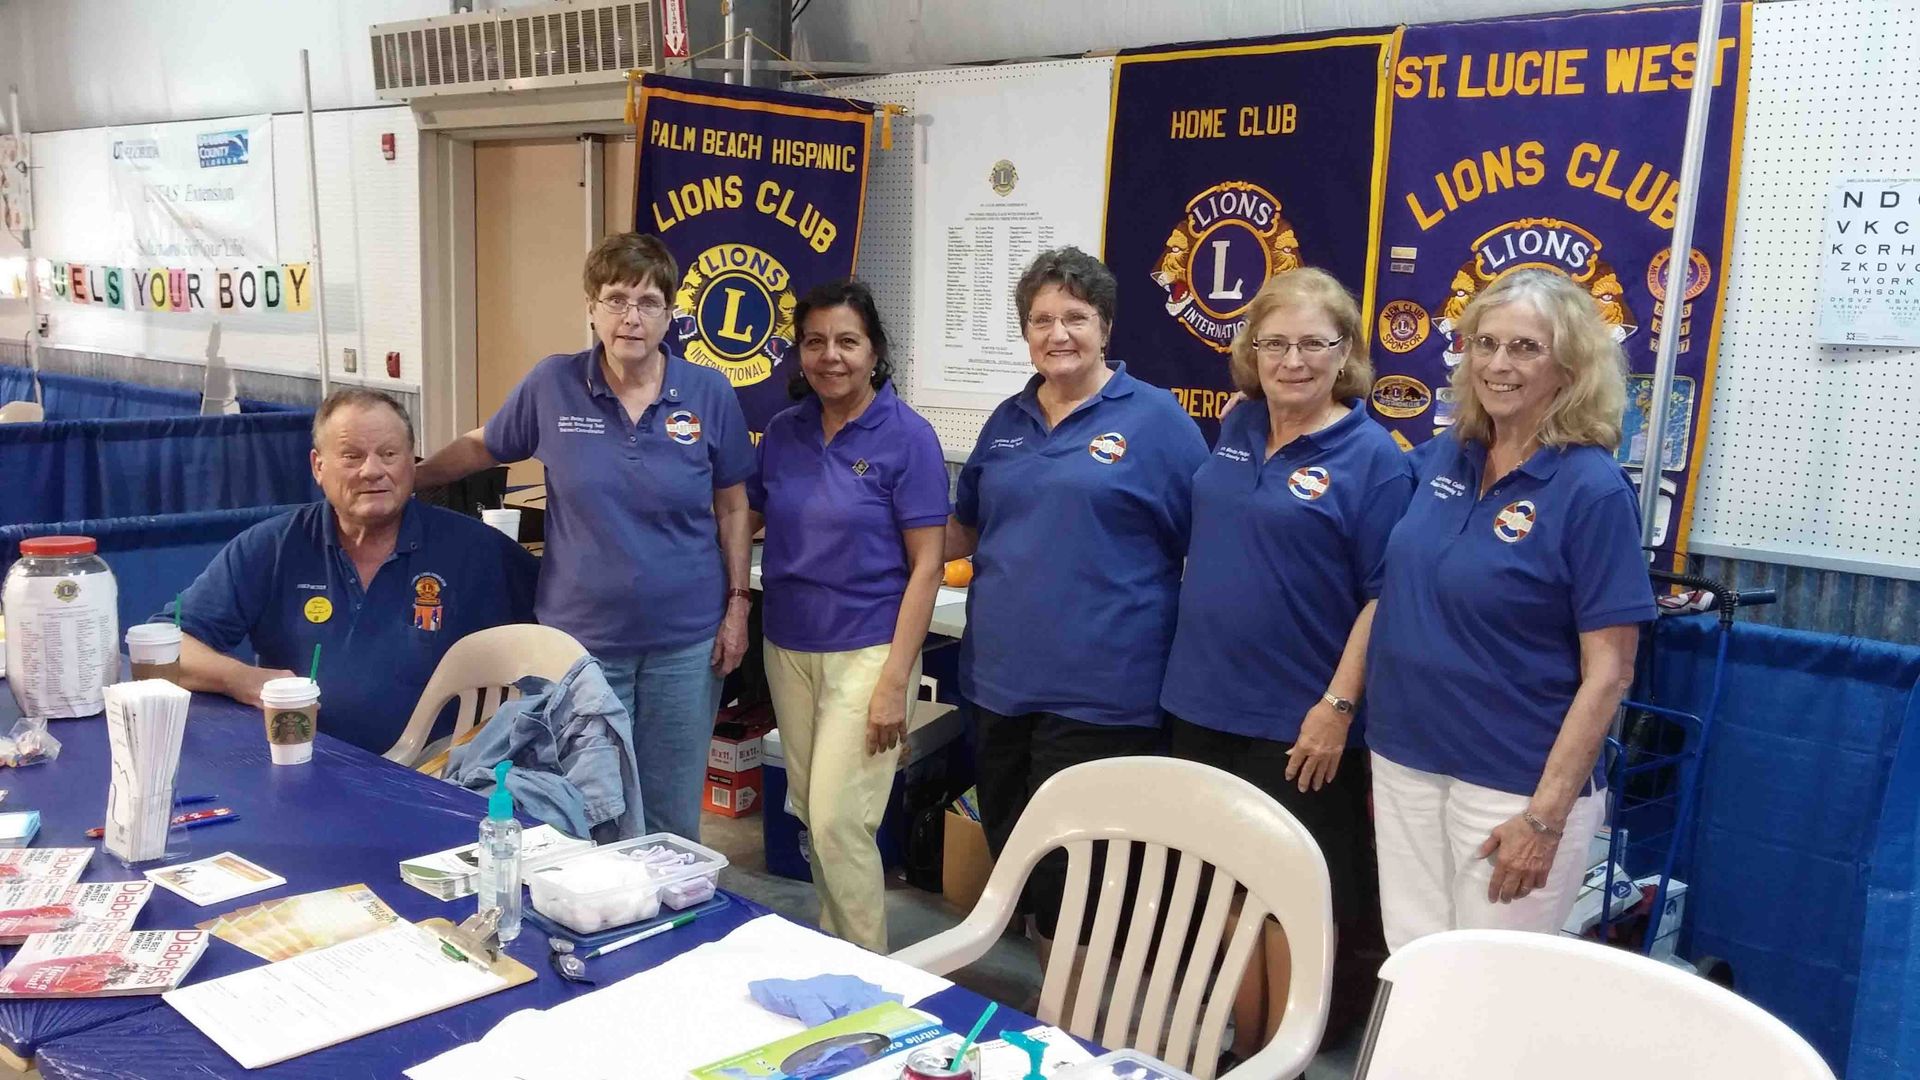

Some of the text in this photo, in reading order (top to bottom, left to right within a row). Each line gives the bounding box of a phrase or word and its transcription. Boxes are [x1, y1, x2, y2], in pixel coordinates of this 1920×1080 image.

[1394, 37, 1736, 99] ST. LUCIE WEST
[1170, 103, 1297, 140] HOME CLUB
[650, 119, 856, 173] PALM BEACH HISPANIC
[1406, 141, 1684, 231] LIONS CLUB
[652, 175, 837, 254] LIONS CLUB
[1193, 192, 1273, 229] LIONS
[703, 246, 785, 288] LIONS
[1480, 229, 1590, 270] LIONS
[38, 264, 306, 309] UELS YOUR BODY
[1208, 240, 1243, 300] L
[718, 287, 753, 343] L
[1183, 306, 1247, 339] INTERNATIO
[1384, 303, 1425, 321] NEW CLUB
[1383, 333, 1422, 350] SPONSOR
[1170, 387, 1240, 419] PIERC
[48, 848, 87, 884] Diabete
[78, 884, 95, 907] WORKOUT
[90, 884, 104, 902] WINTER
[97, 892, 108, 904] BEST
[98, 883, 147, 932] Diabetes
[128, 932, 146, 954] WORKOUT
[142, 932, 155, 950] WINTER
[144, 931, 203, 985] Diabetes
[148, 941, 162, 953] BEST
[905, 1028, 940, 1044] nitrile
